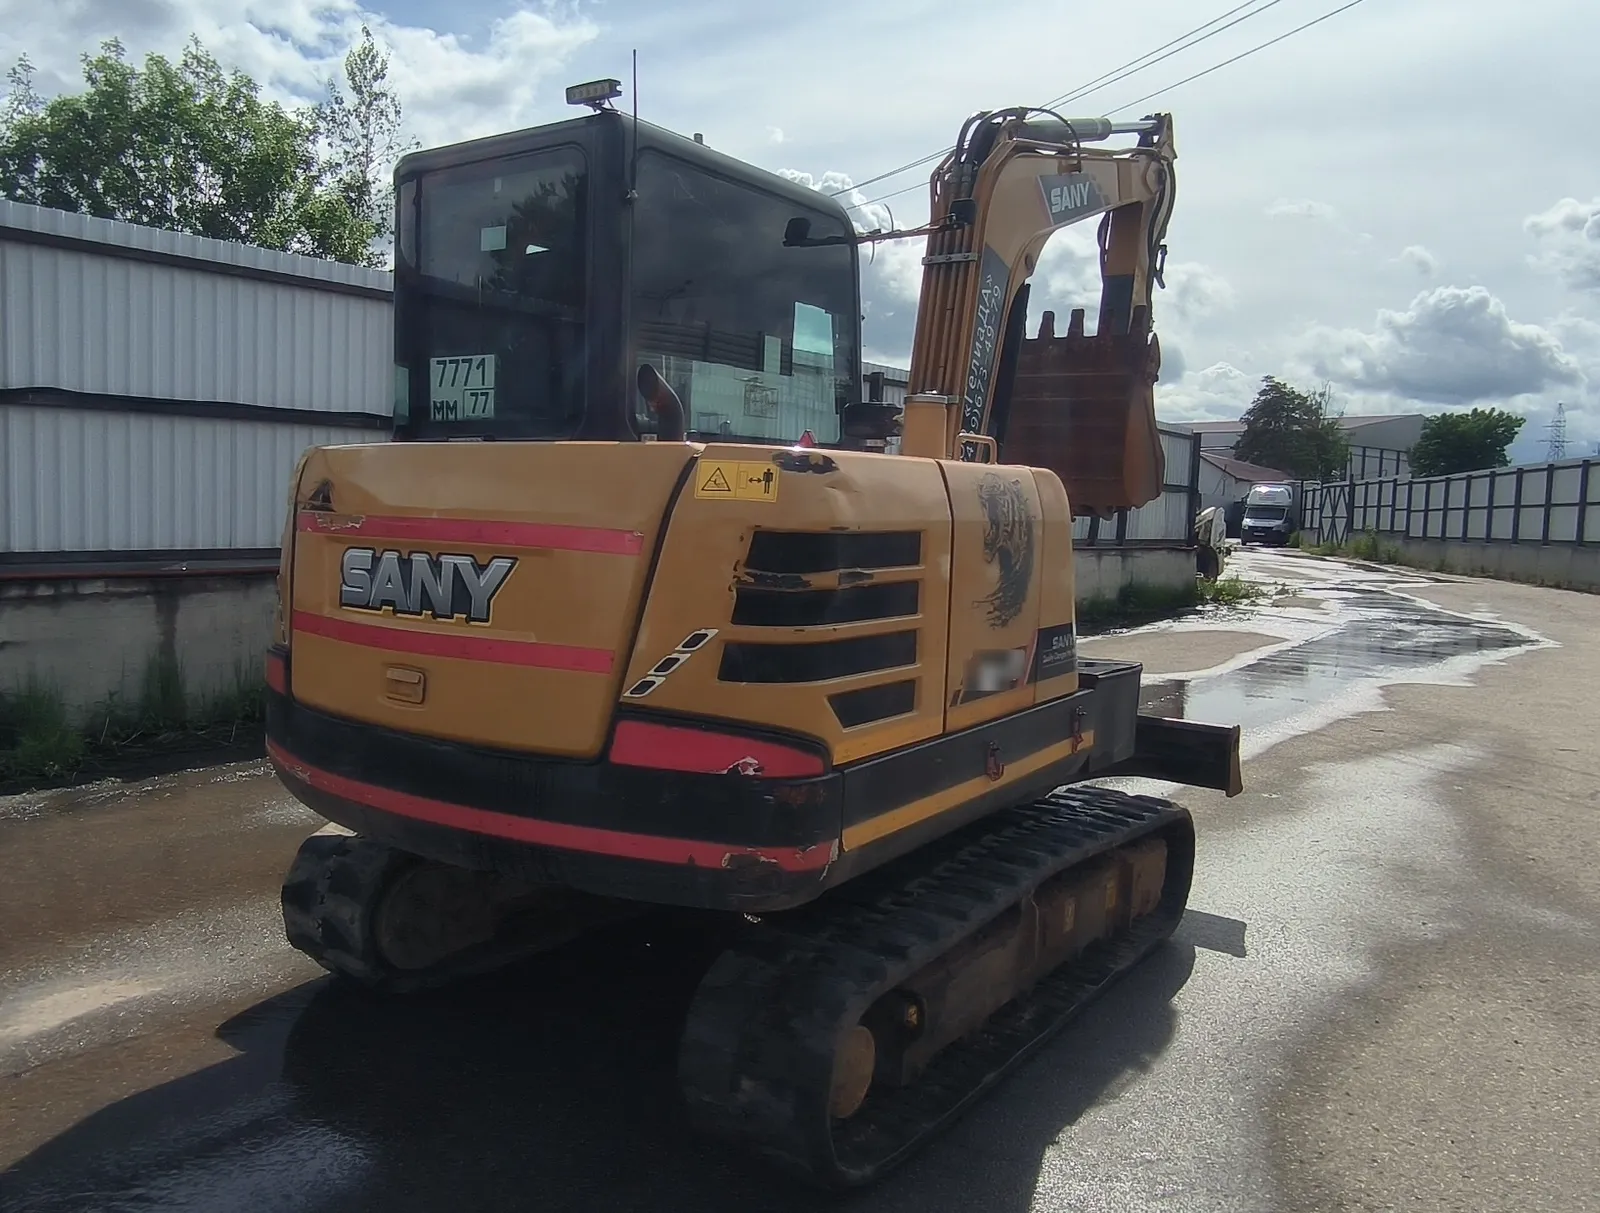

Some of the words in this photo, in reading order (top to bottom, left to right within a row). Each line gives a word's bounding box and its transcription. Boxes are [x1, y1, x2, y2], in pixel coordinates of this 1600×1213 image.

[1050, 181, 1090, 214] SANY
[436, 357, 486, 388] 7771
[469, 391, 490, 414] 77
[340, 547, 518, 623] SANY
